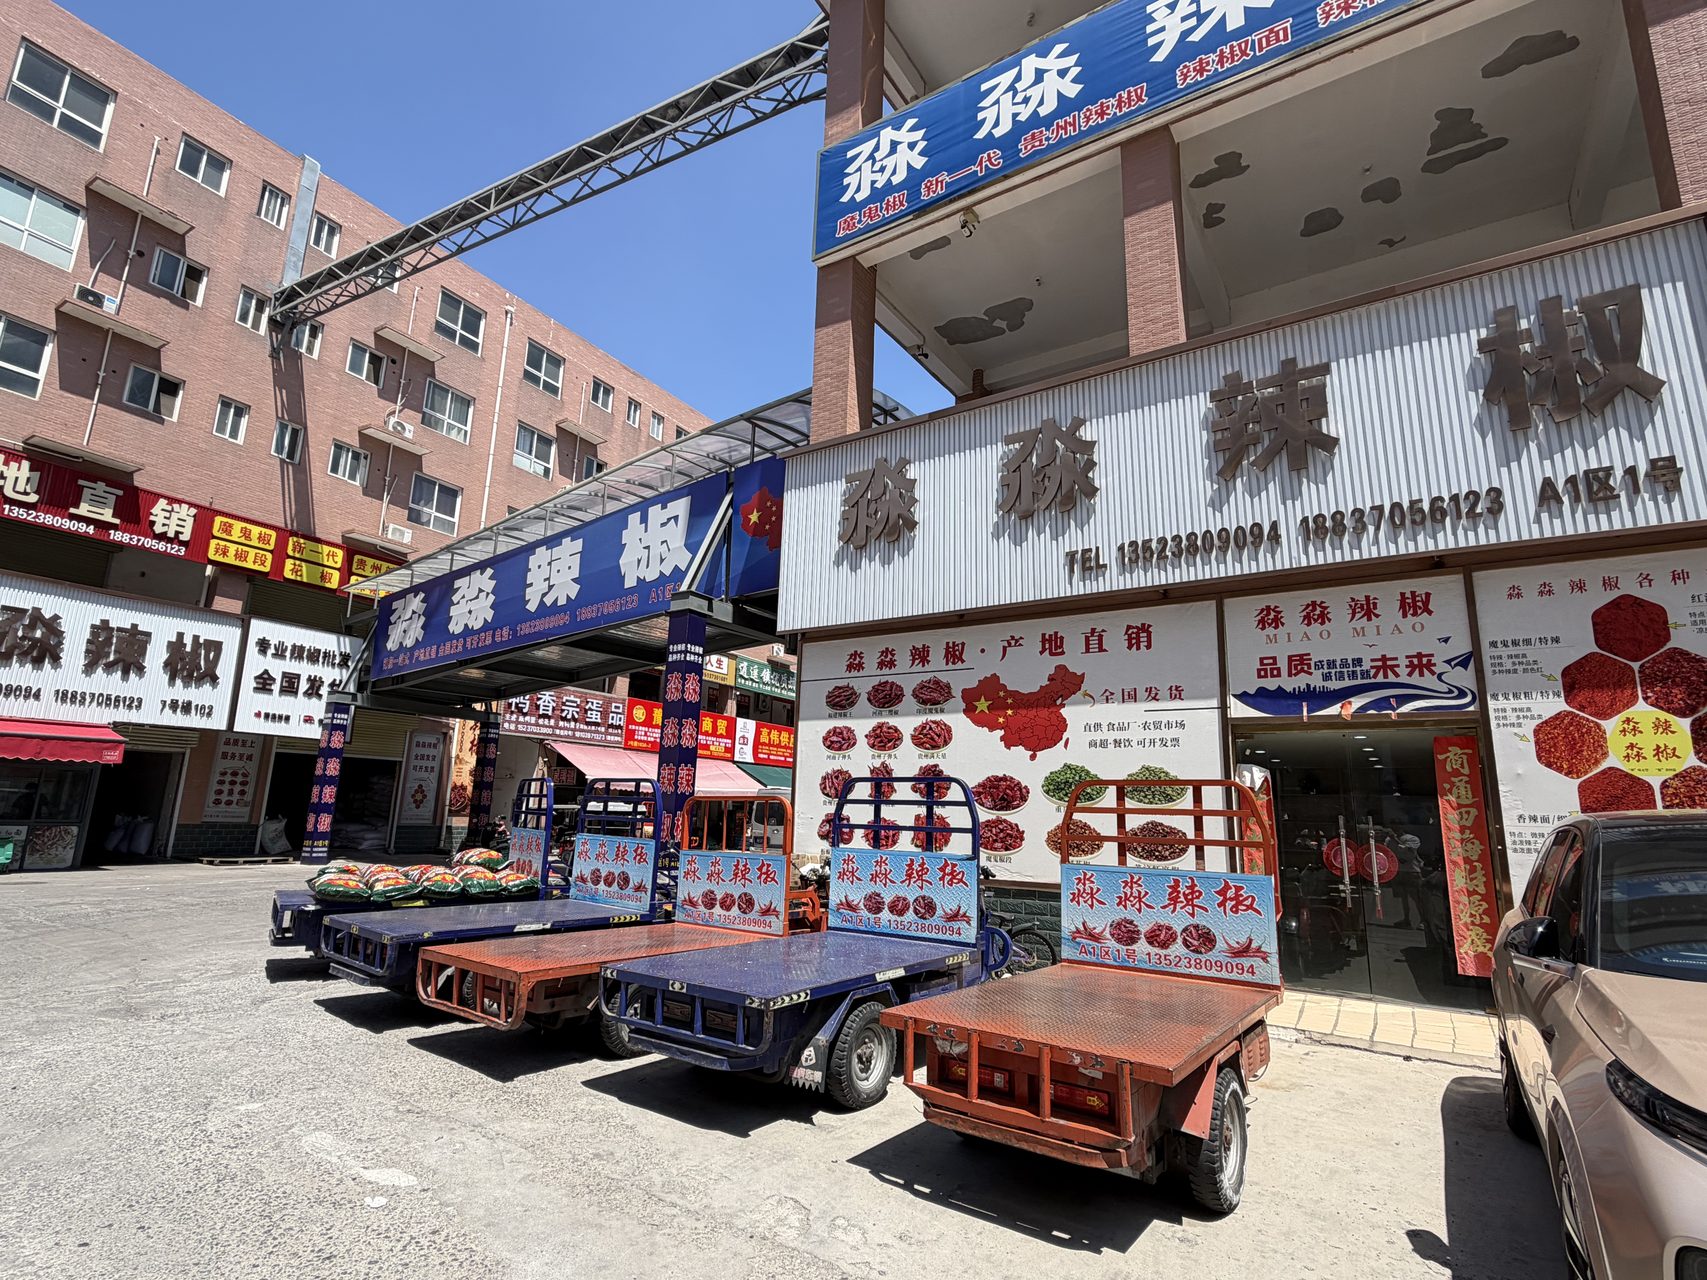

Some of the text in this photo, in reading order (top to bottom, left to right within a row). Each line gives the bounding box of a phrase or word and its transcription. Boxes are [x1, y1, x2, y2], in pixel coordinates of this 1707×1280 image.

[836, 190, 907, 237] 魔鬼椒
[921, 149, 1003, 200] 新一代
[1018, 82, 1149, 157] 贵州辣椒
[1176, 18, 1292, 88] 辣椒面
[838, 283, 1667, 549] 淼淼辣椒
[0, 454, 197, 542] 地直销
[2, 503, 186, 556] 13523809094 18837056123
[1066, 455, 1684, 575] TEL 13523809094 18837056123 A1区1号
[217, 520, 394, 575] 魔鬼椒 新一代 贵州
[213, 542, 269, 568] 辣椒段
[289, 562, 333, 585] 花椒
[384, 496, 692, 651] 淼淼辣椒
[1254, 590, 1435, 631] 淼淼辣椒
[1690, 592, 1707, 604] 红
[1265, 621, 1426, 645] MIAO MIAO
[1488, 635, 1561, 649] 魔鬼椒细/特辣
[255, 637, 352, 669] 专业辣椒批发
[1256, 652, 1437, 680] 品质 成就品牌 未来
[1321, 669, 1372, 682] 诚信铸就
[0, 683, 42, 702] 9094
[53, 689, 144, 711] 18837056123
[1100, 685, 1185, 705] 全国发货
[1489, 690, 1563, 702] 魔鬼椒粗/特辣
[701, 717, 728, 736] 商贸
[1082, 722, 1103, 734] 直供
[1136, 737, 1181, 749] 可开发票
[576, 837, 649, 868] 淼淼辣椒
[683, 854, 780, 888] 淼淼辣椒
[836, 853, 970, 892] 淼淼辣椒
[601, 889, 643, 904] 13523809094
[1069, 870, 1265, 919] 淼淼辣椒
[717, 913, 773, 929] 13523809094
[840, 914, 963, 937] A1区1号 13523809094
[1078, 943, 1257, 977] A1区1号 13523809094
